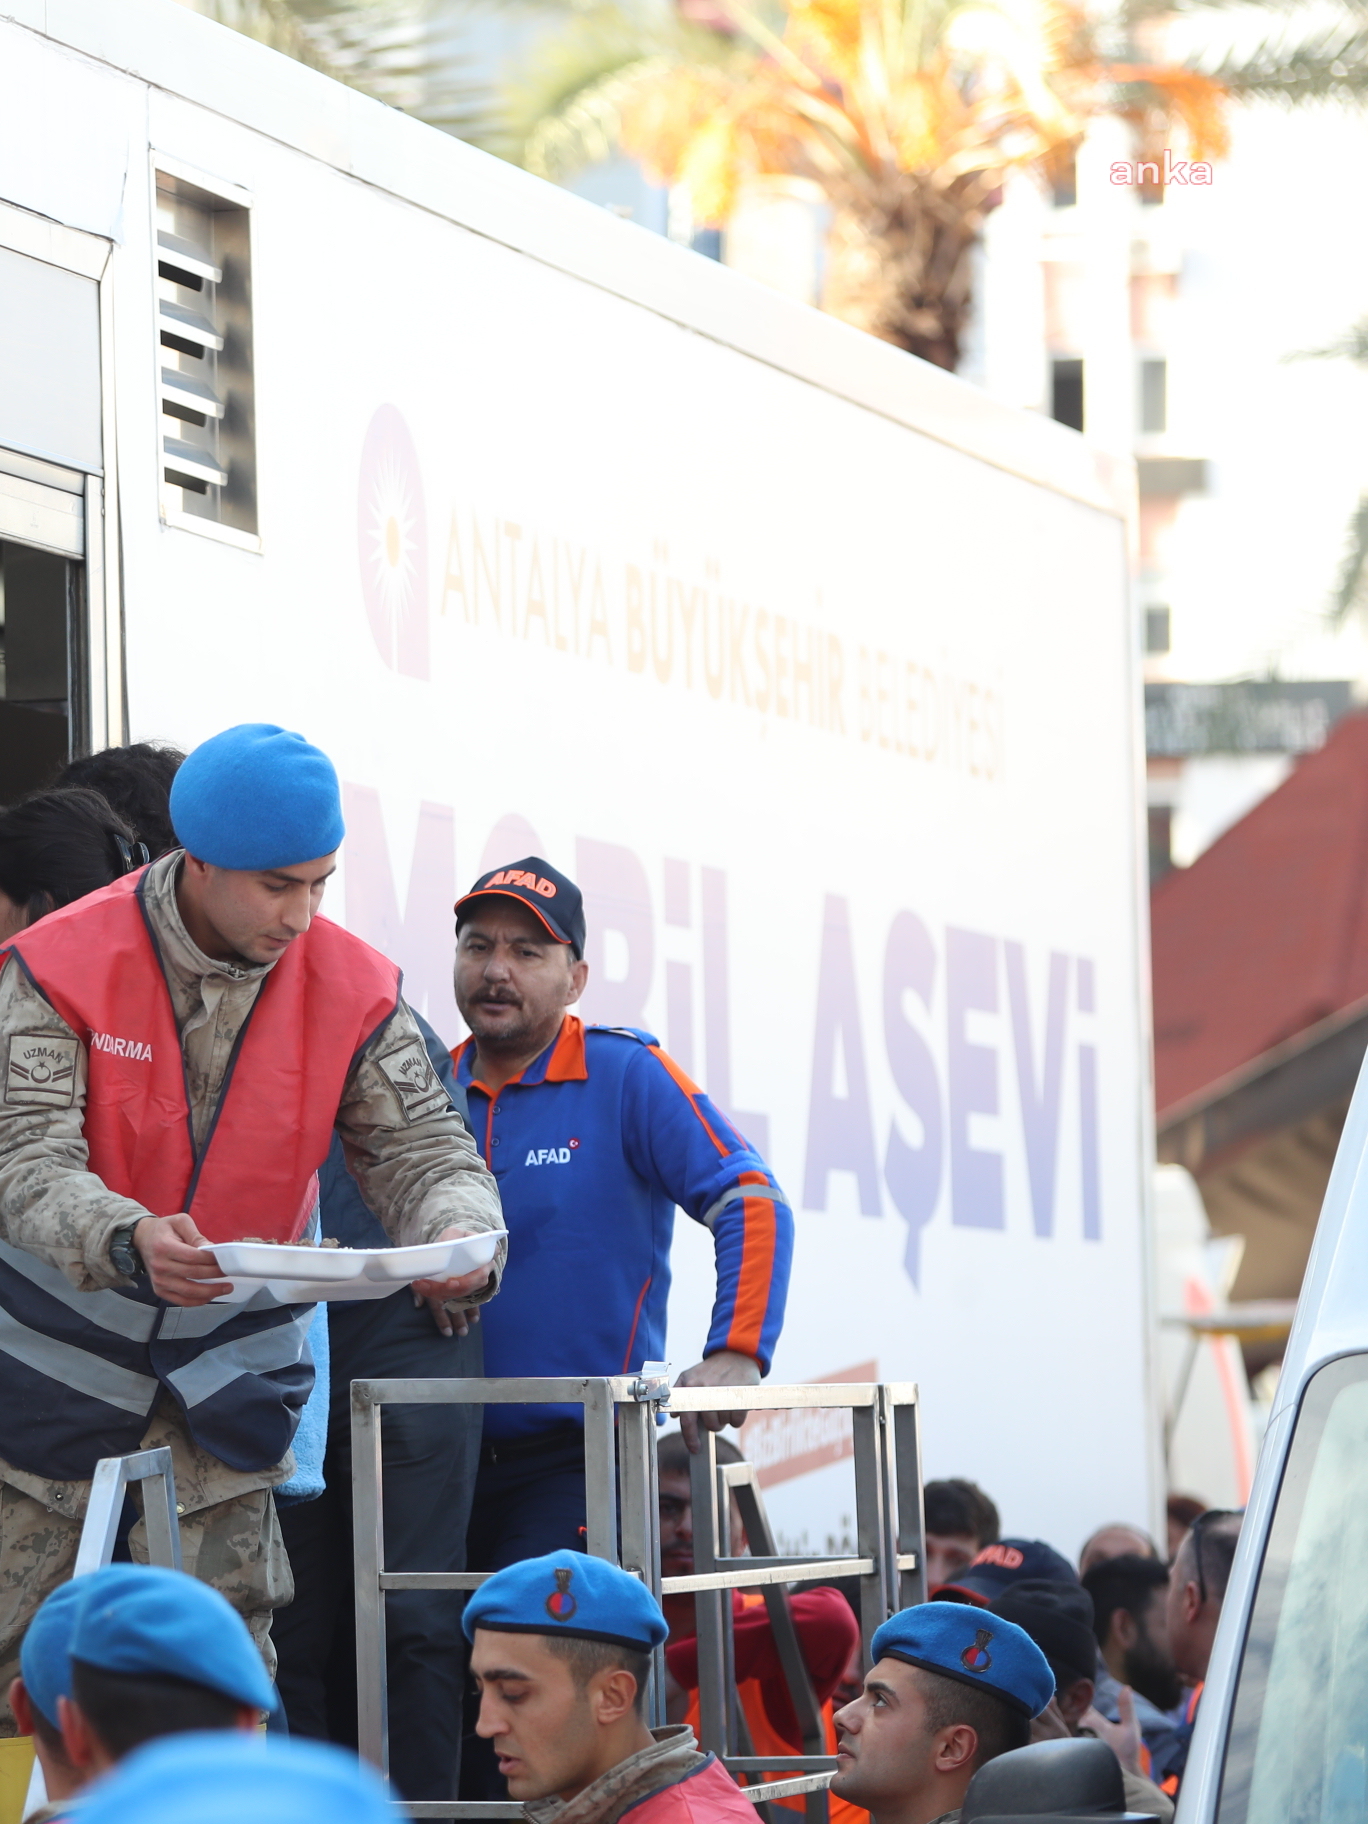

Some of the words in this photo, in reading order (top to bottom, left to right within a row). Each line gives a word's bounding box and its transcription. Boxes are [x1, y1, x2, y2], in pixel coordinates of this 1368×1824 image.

[440, 498, 614, 666] ANTALYA
[625, 536, 847, 741] BÜYÜKŞEHİR
[857, 642, 1007, 783] BELEDİYESİ
[484, 869, 557, 898] AFAD
[23, 1046, 65, 1064] UZMAN
[88, 1029, 153, 1062] NDARMA
[398, 1057, 422, 1076] UZMAN
[524, 1147, 571, 1166] AFAD
